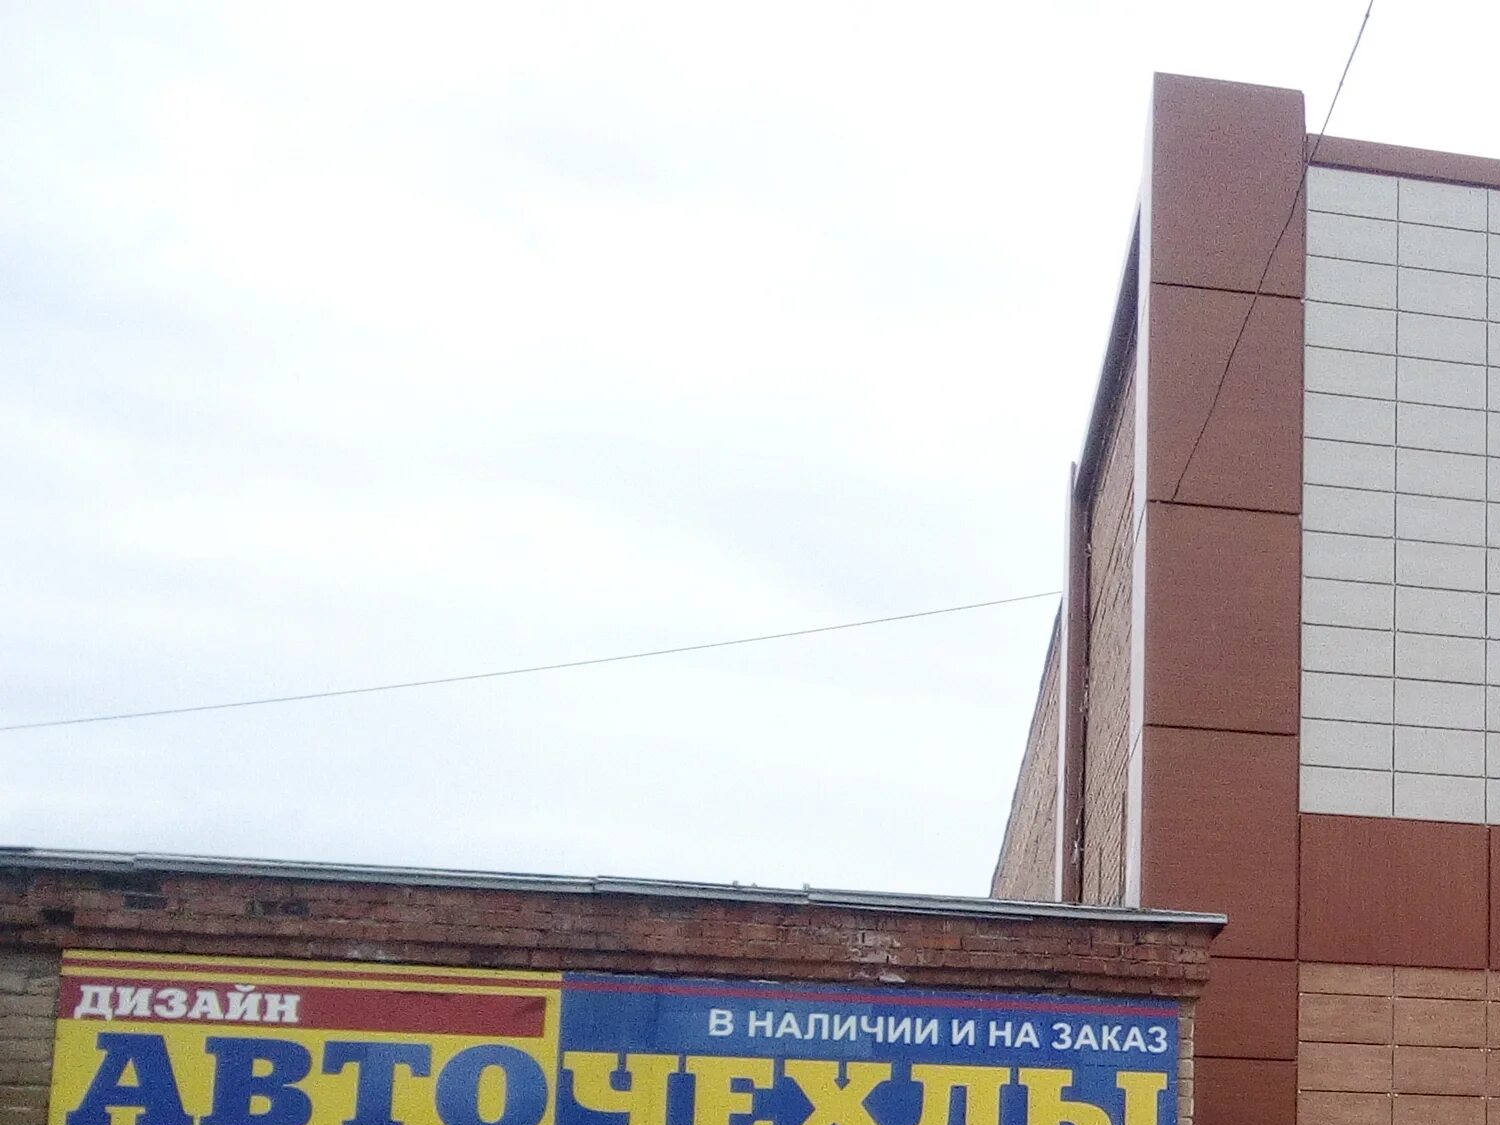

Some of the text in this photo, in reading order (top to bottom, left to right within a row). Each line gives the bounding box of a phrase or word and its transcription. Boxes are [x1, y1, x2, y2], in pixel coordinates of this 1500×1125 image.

[74, 984, 300, 1023] ДИЗАЙН
[709, 1008, 1168, 1054] В НАЛИЧИИ И НА ЗАКАЗ
